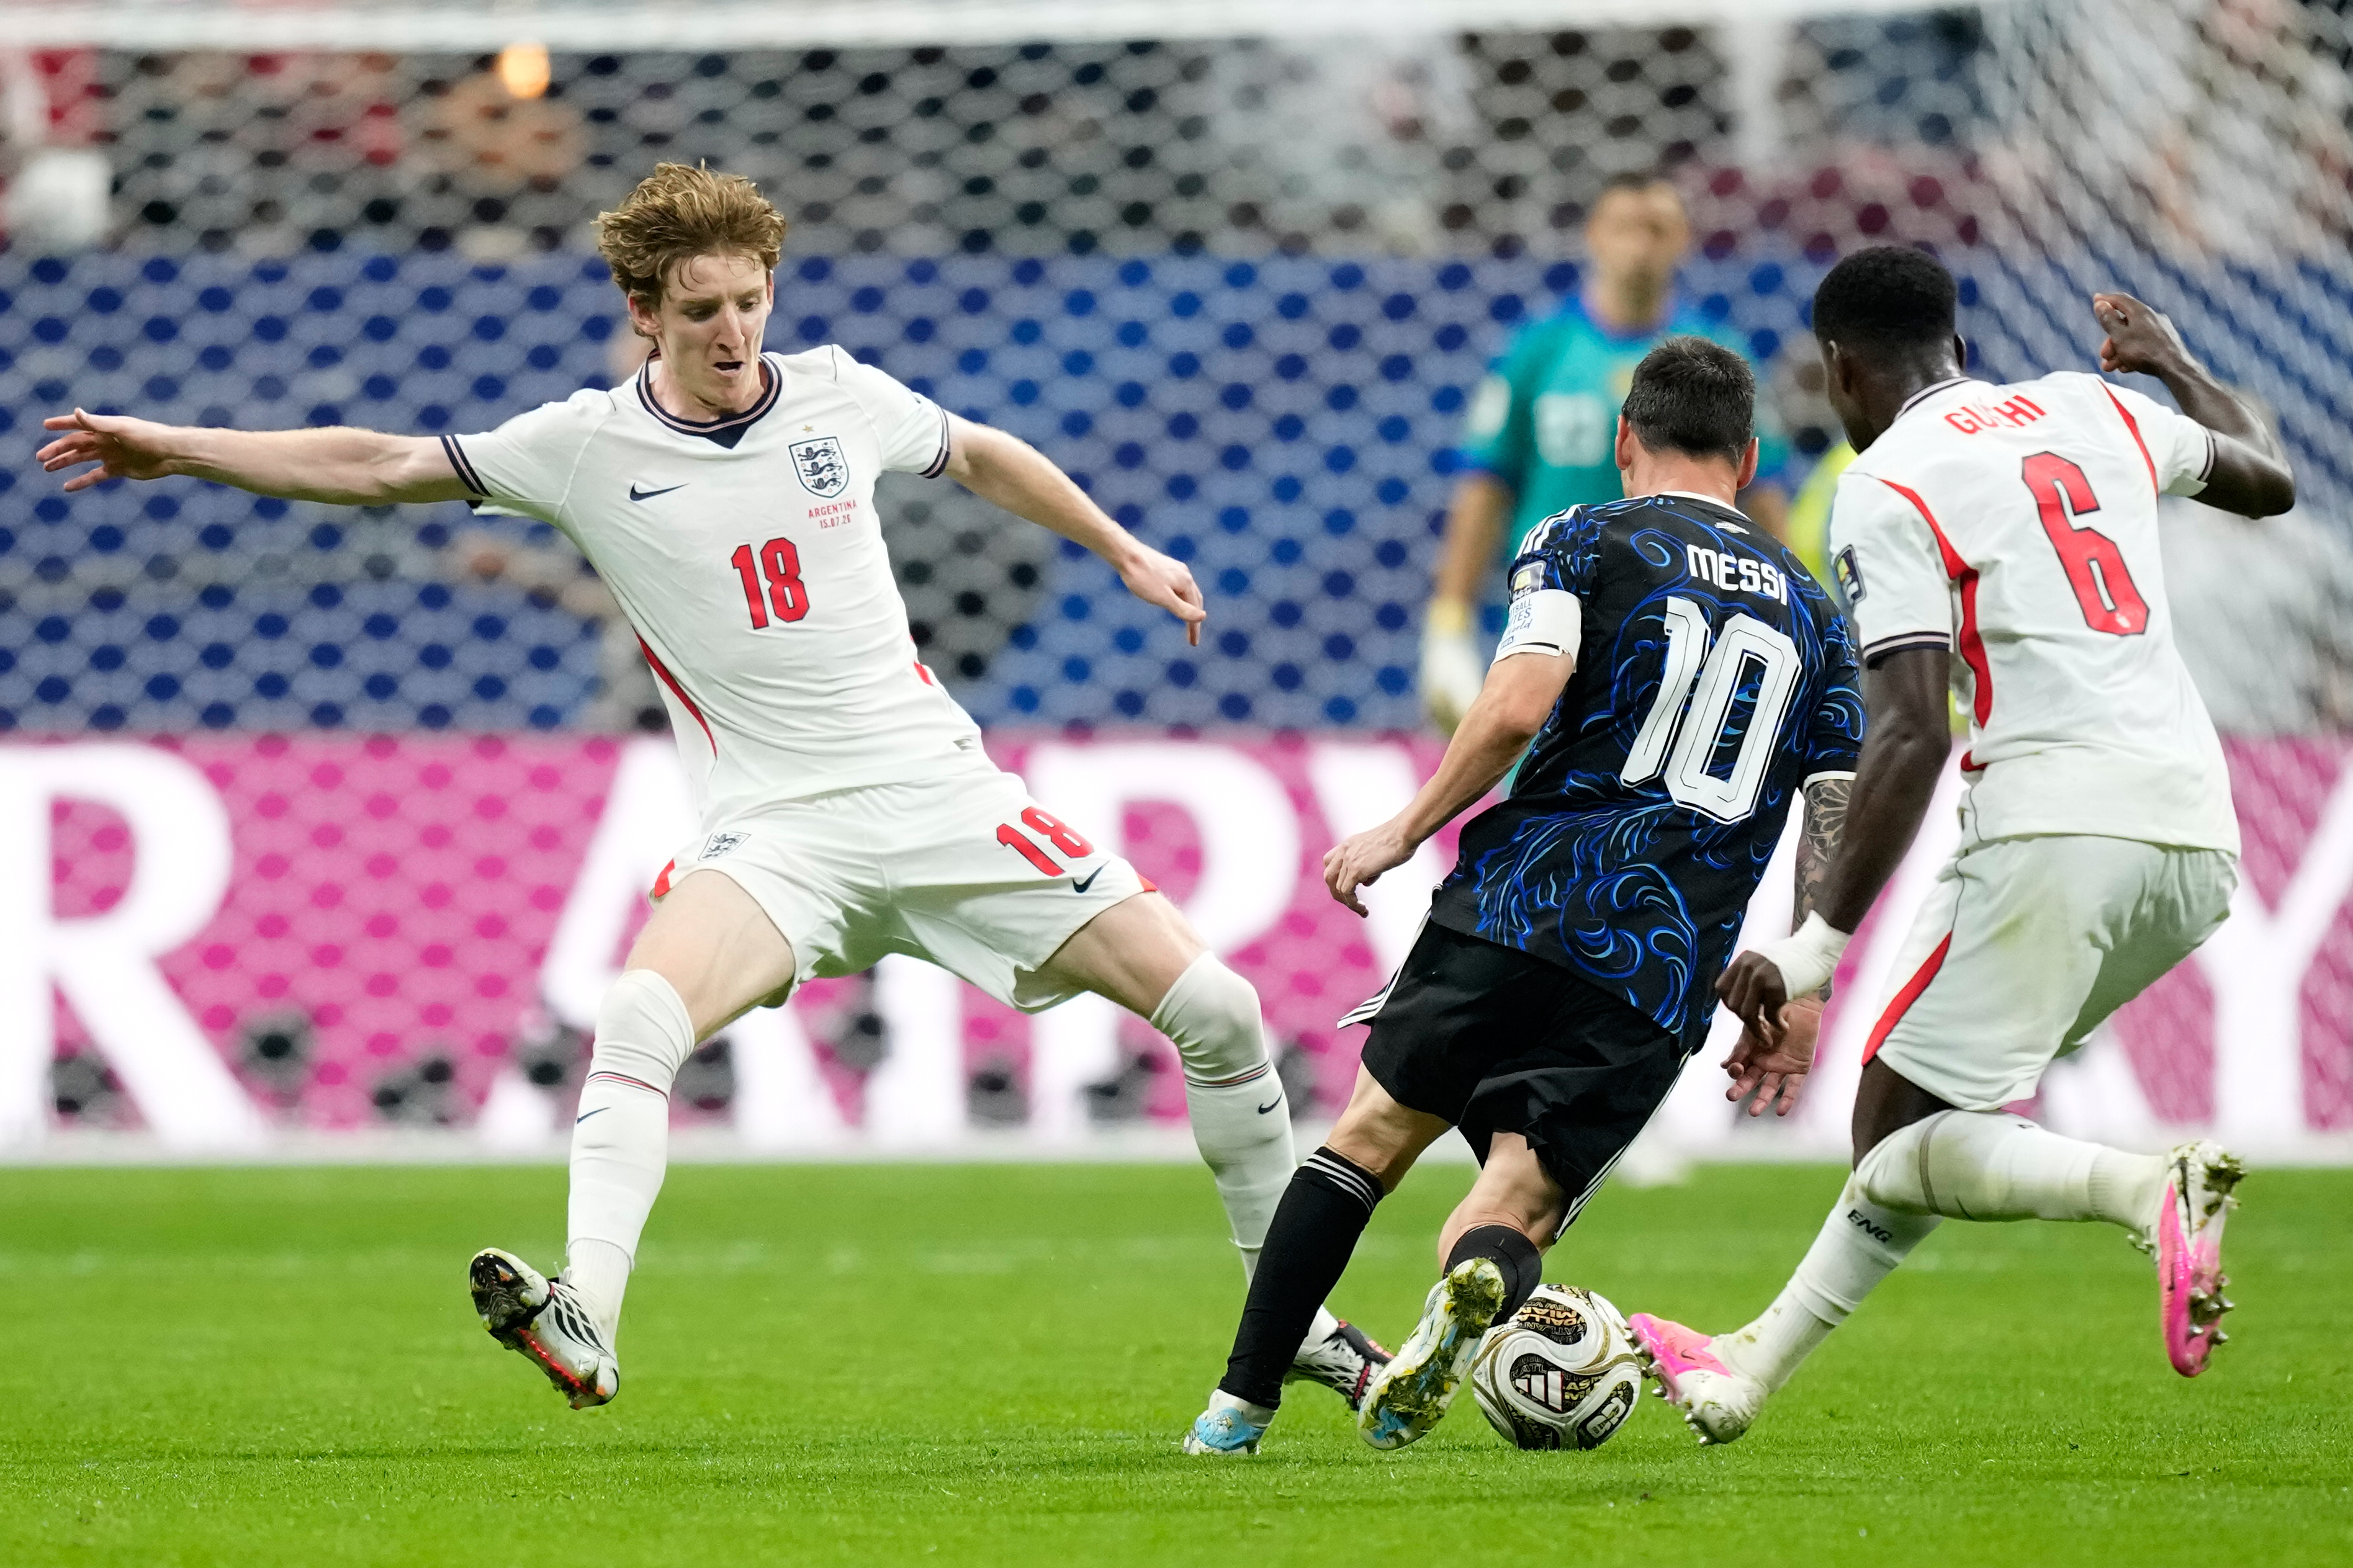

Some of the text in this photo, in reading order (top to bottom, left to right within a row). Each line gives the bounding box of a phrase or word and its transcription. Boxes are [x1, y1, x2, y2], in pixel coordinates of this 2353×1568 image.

[1944, 395, 2046, 434] GUHI
[809, 499, 857, 519] ARGENTINA
[819, 514, 851, 529] 15.07.26
[2021, 450, 2150, 637] 6
[731, 537, 810, 630] 18
[1687, 544, 1788, 606] MESSI
[1511, 599, 1532, 615] TBALL
[1620, 596, 1801, 825] 10
[996, 806, 1095, 877] 18
[1847, 1209, 1893, 1243] ENG
[1517, 1314, 1577, 1326] DALLA
